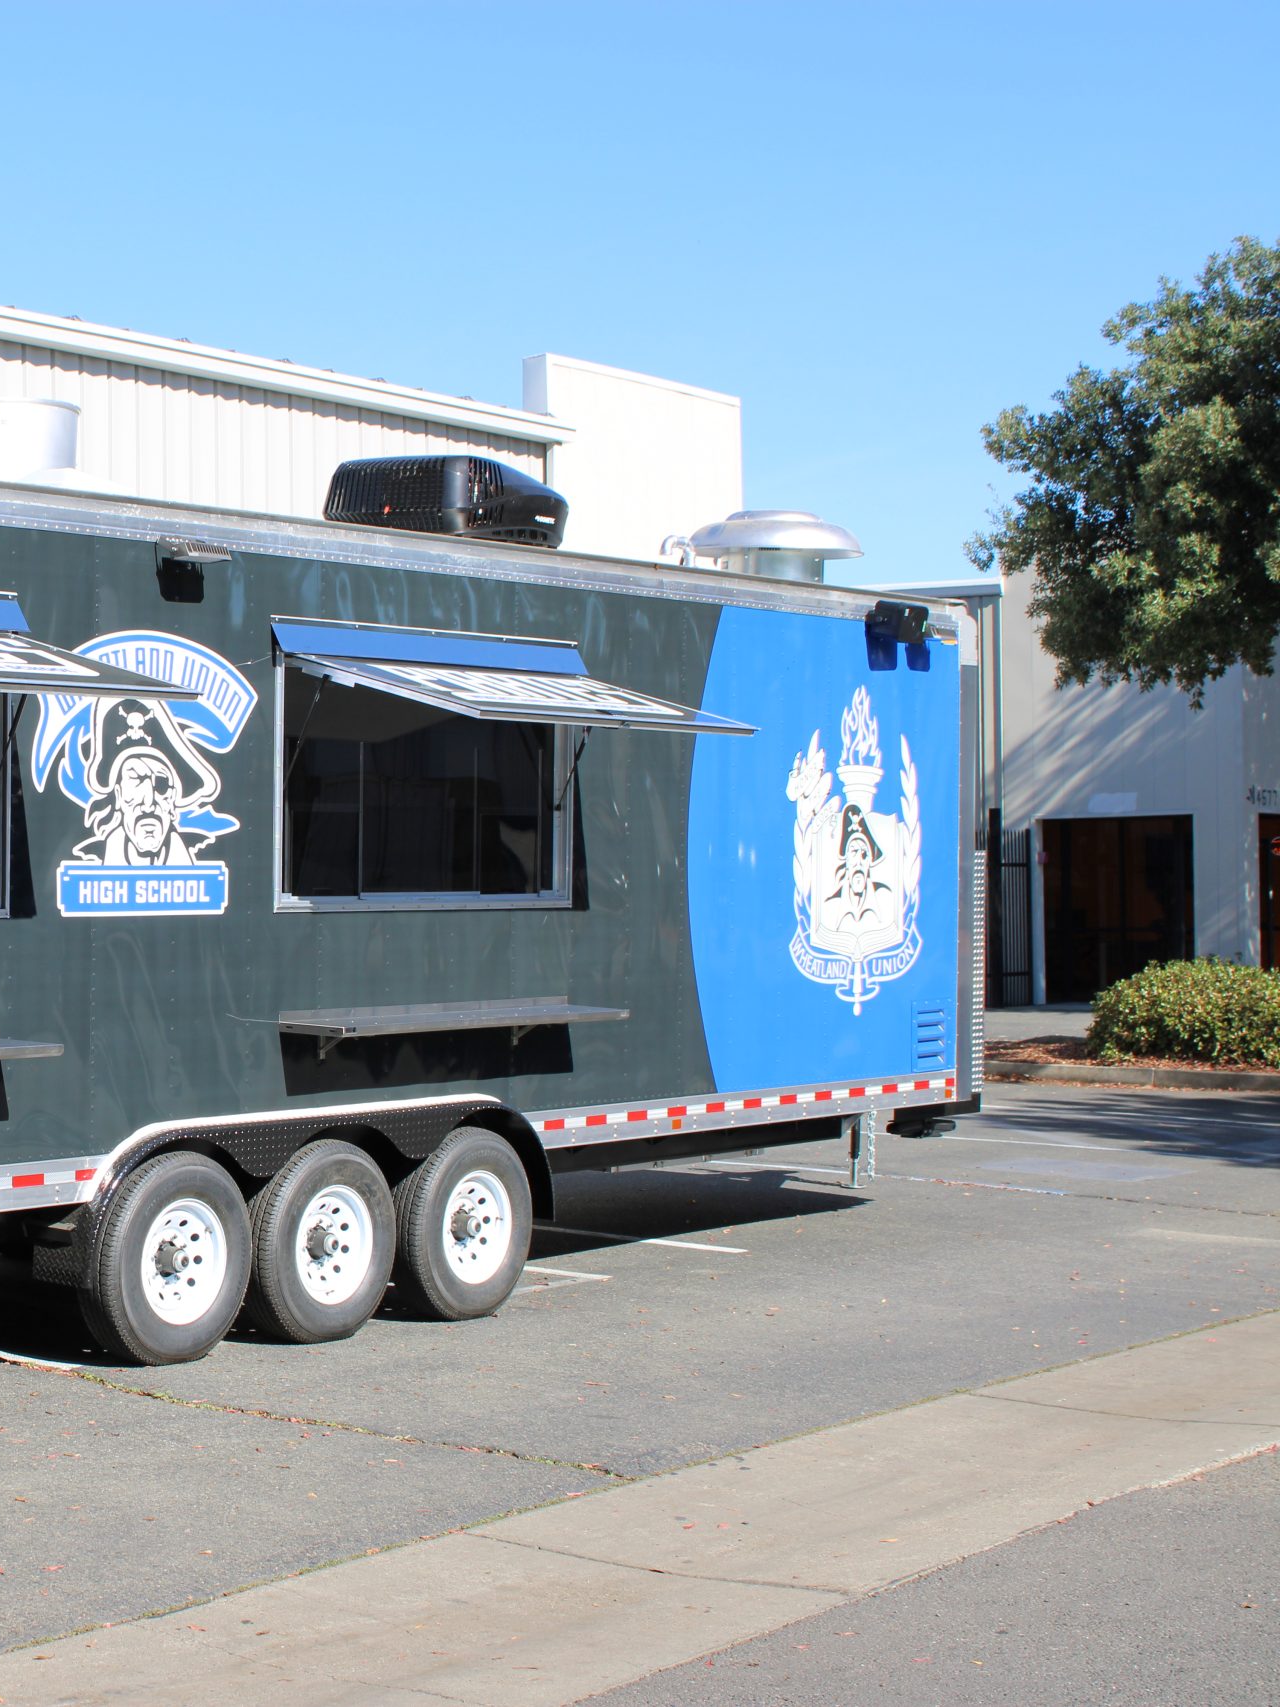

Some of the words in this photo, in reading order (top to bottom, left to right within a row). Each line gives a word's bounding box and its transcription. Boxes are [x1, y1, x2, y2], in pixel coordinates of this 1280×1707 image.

[180, 655, 242, 723] UNION
[79, 880, 128, 904] HIGH
[135, 879, 210, 903] SCHOOL
[792, 938, 847, 978] WHEATLAND
[872, 941, 914, 976] UNION
